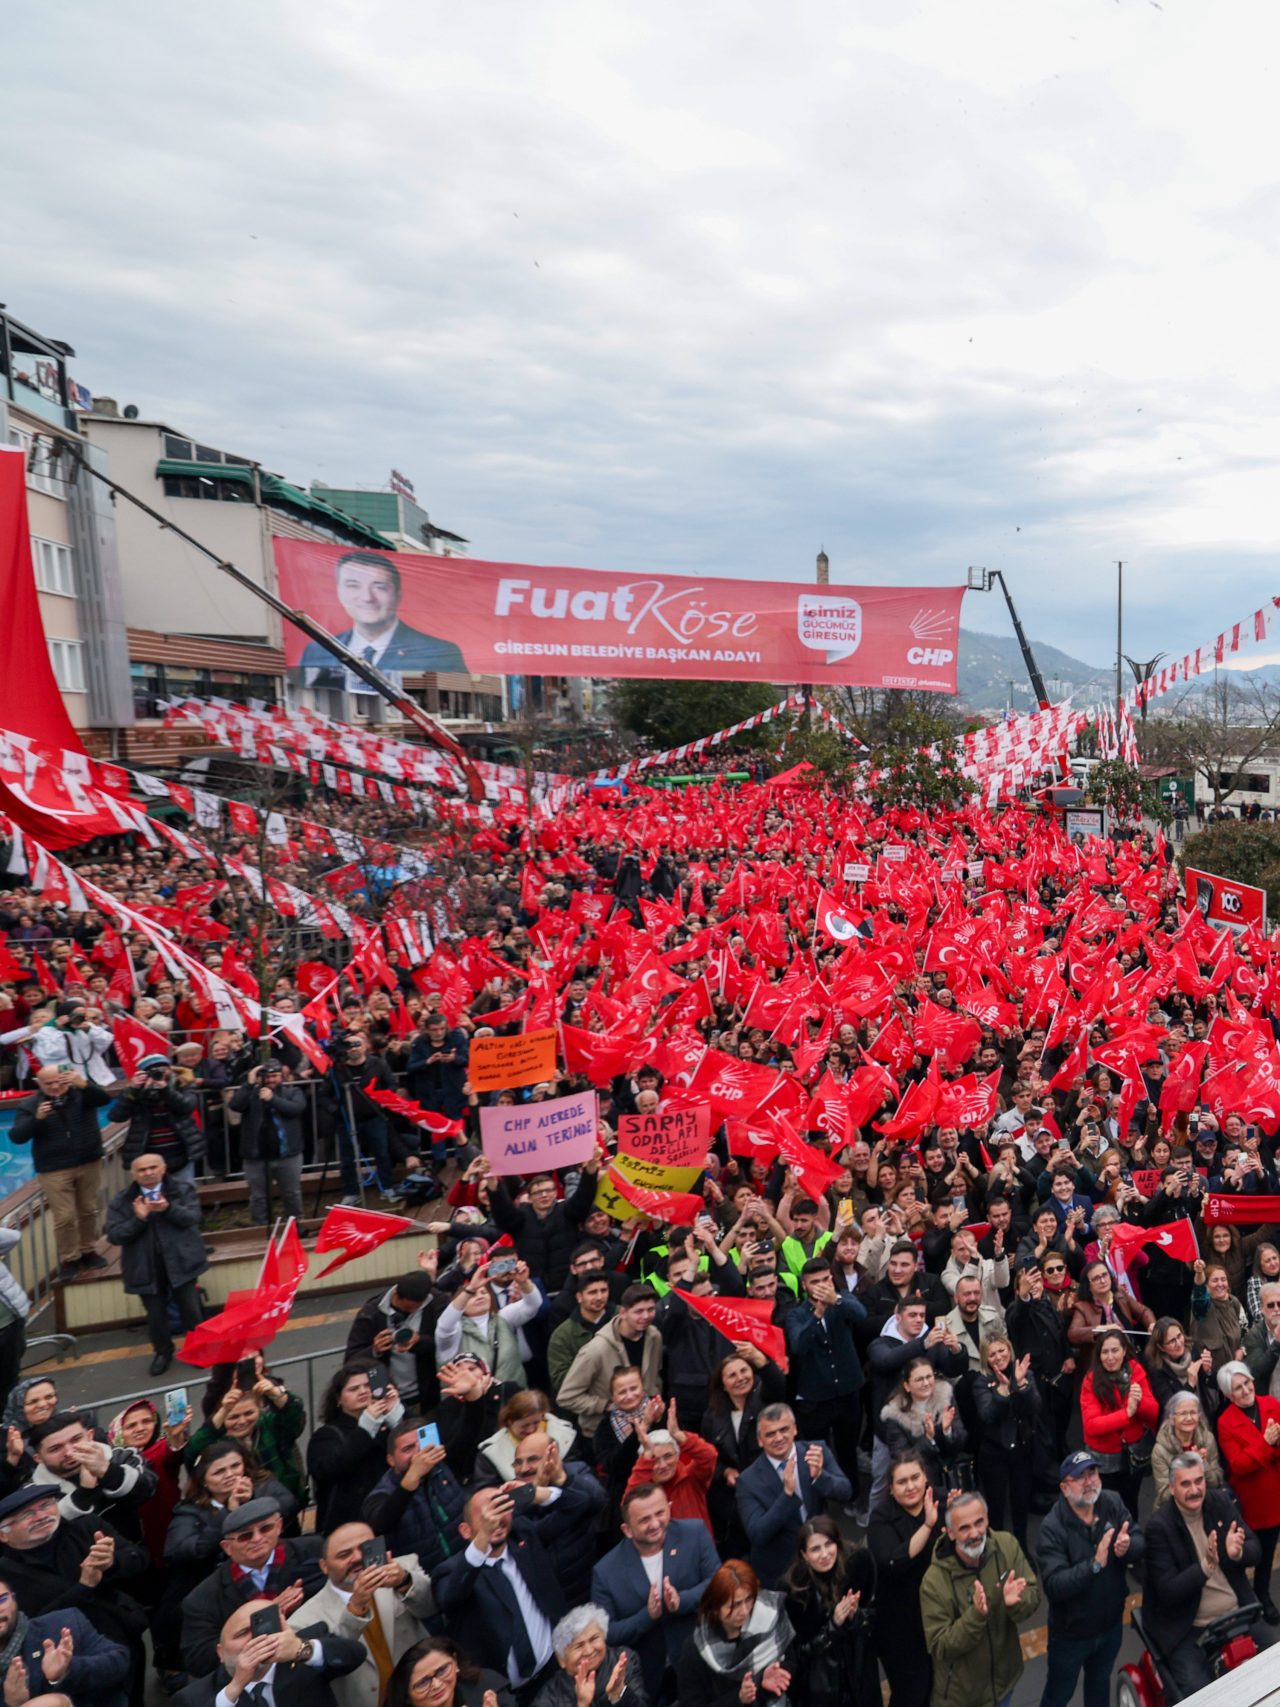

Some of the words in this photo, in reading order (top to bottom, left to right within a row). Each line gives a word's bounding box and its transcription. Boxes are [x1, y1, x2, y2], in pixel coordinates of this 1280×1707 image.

[494, 578, 634, 622] Fuat
[627, 580, 759, 645] Köse
[803, 619, 857, 631] GÜCÜMÜZ
[803, 630, 857, 642] GİRESUN
[494, 640, 568, 657] GİRESUN
[571, 643, 643, 659] BELEDİYE
[646, 646, 711, 664] BAŞKAN
[713, 649, 761, 663] ADAYI
[906, 646, 954, 667] CHP
[980, 1005, 1000, 1026] CHP
[709, 1082, 744, 1101] CHP
[504, 1117, 531, 1132] CHP
[537, 1104, 585, 1129] NEREDE
[625, 1111, 697, 1133] SARAY
[504, 1140, 537, 1156] ALIN
[1209, 1198, 1219, 1218] CHP
